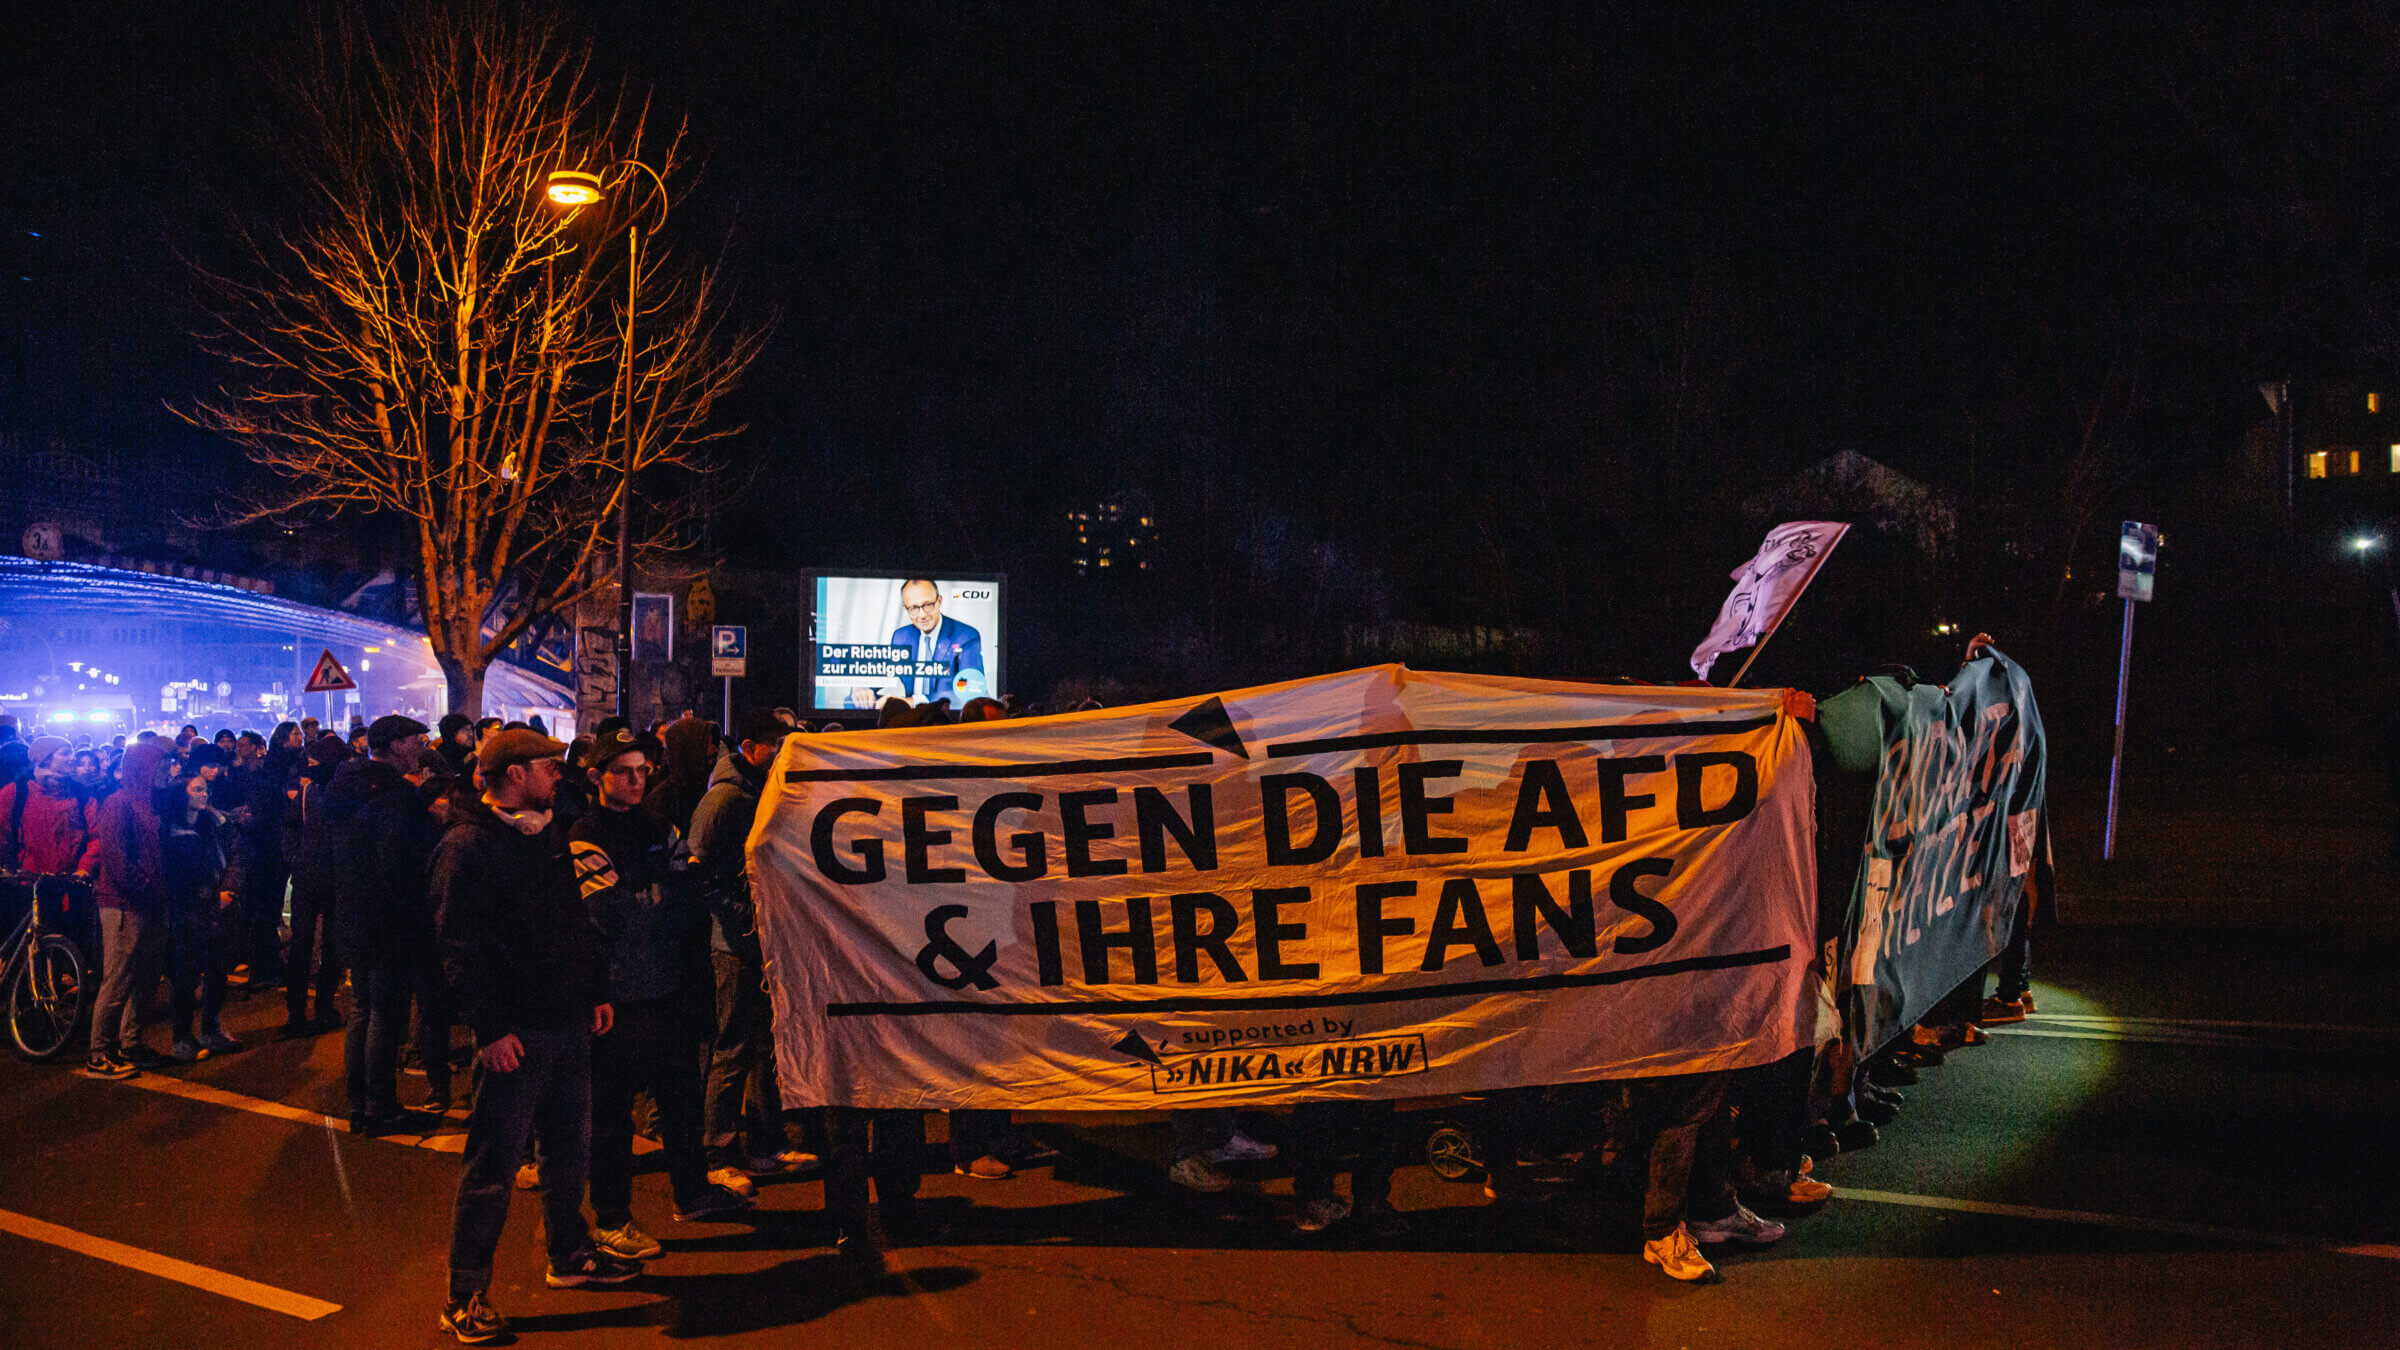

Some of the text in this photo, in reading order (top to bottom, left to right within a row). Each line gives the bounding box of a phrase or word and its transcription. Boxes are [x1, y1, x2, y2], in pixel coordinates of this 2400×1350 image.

[962, 590, 990, 600] CDU
[718, 630, 736, 655] P
[822, 645, 910, 660] Der Richtige
[822, 661, 946, 677] zur richtigen Zeit.
[810, 751, 1758, 885] GEGEN DIE AFD
[916, 857, 1679, 991] & IHRE FANS
[1183, 1017, 1353, 1046] supported by
[1320, 1043, 1416, 1077] NRW
